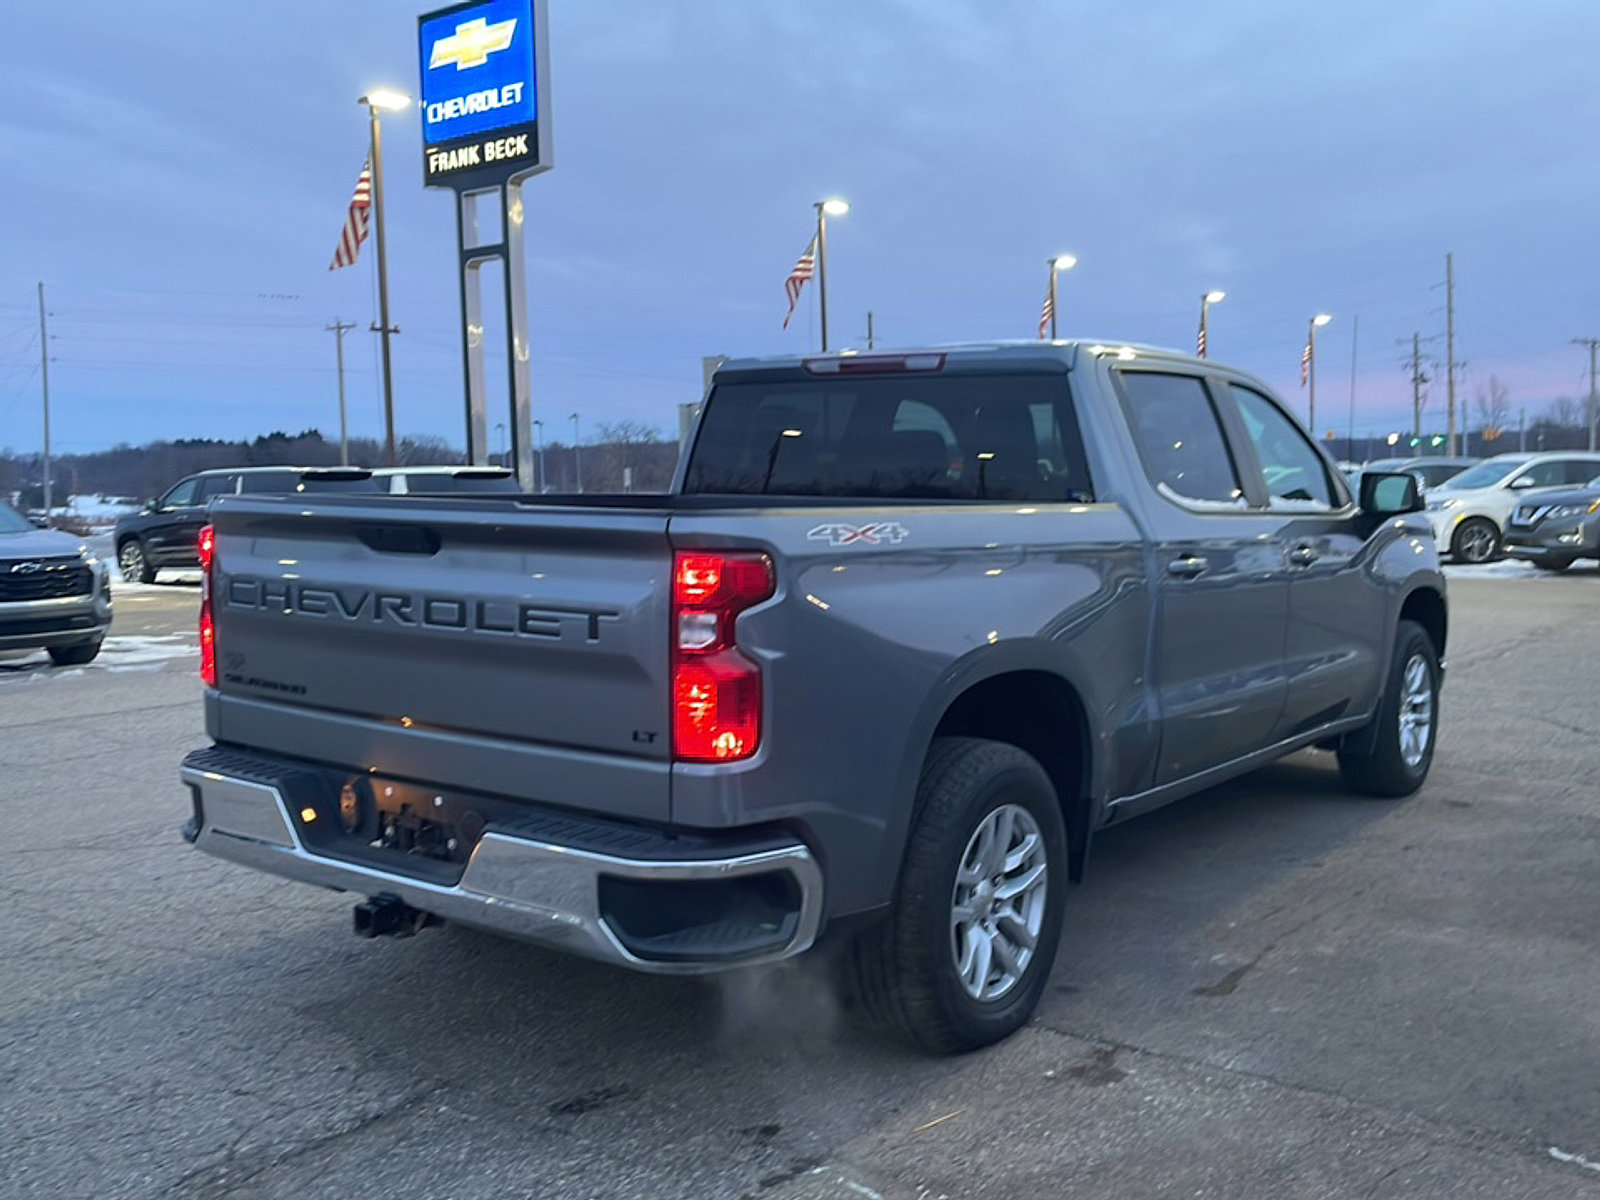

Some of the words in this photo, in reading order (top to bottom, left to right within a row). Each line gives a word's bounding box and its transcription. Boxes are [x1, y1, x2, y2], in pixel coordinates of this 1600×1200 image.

[427, 82, 524, 124] CHEVROLET
[427, 144, 480, 174] FRANK
[484, 134, 528, 162] BECK
[227, 578, 619, 643] CHEVROLET
[632, 730, 659, 744] LT
